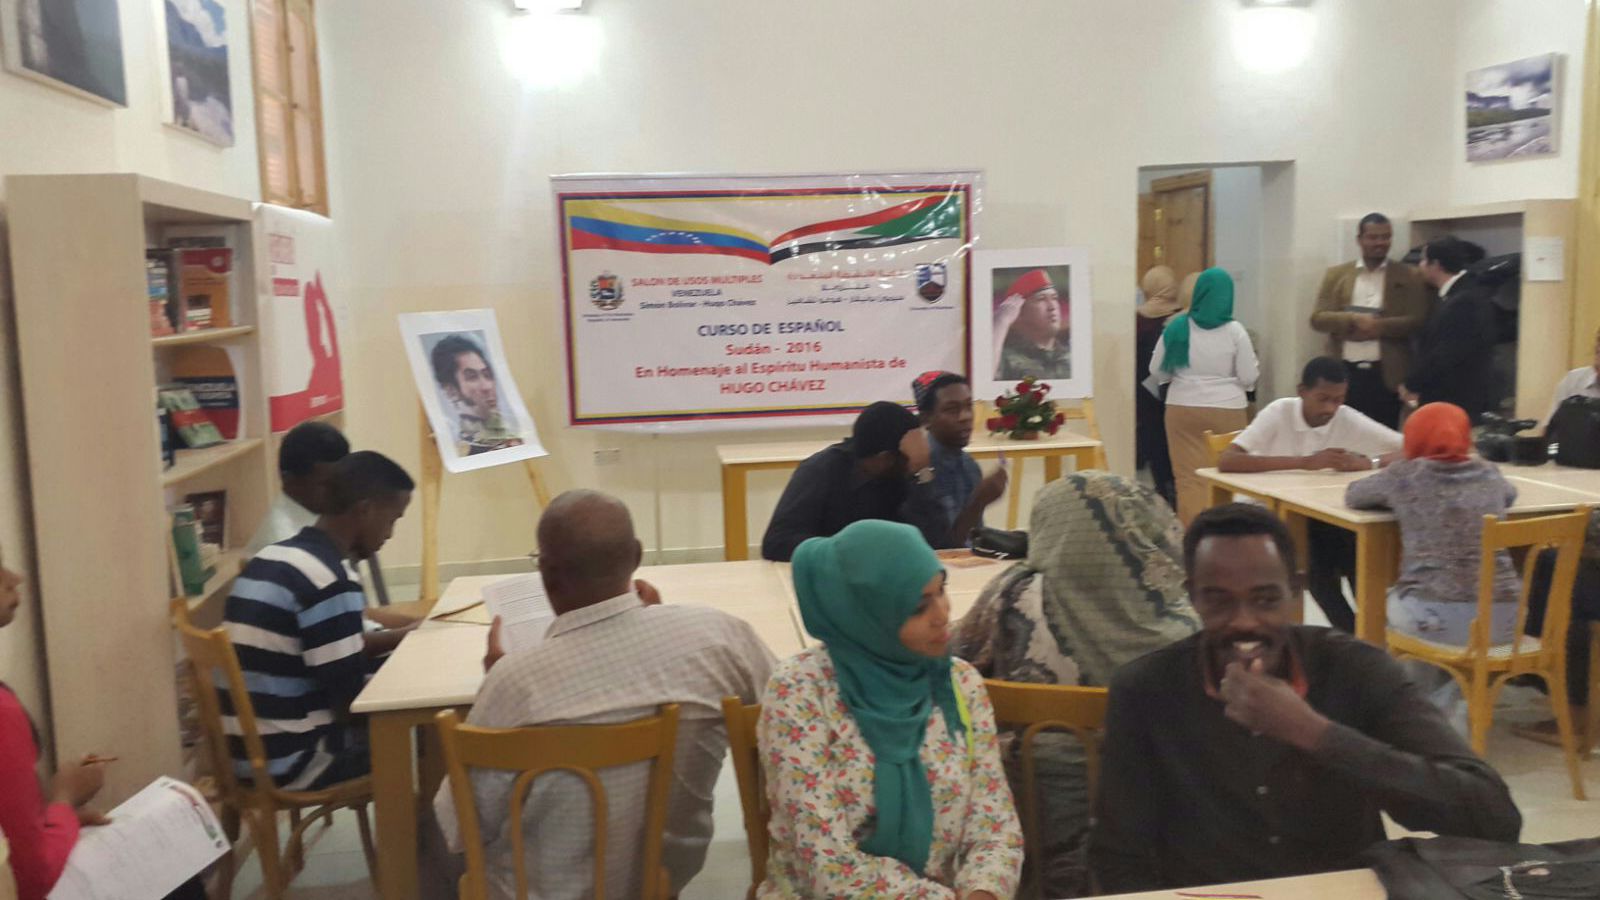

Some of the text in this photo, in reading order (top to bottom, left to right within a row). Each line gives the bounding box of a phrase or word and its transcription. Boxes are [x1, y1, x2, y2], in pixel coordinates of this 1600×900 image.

[697, 318, 845, 337] CURSO DE ESPAÑOL
[725, 342, 771, 356] Sudán
[786, 340, 822, 354] 2016
[635, 366, 654, 379] En
[657, 363, 732, 379] Homenaje
[735, 362, 748, 375] al
[810, 358, 885, 372] Humanista
[888, 356, 907, 369] de
[720, 378, 826, 395] HUGO CHÁVEZ
